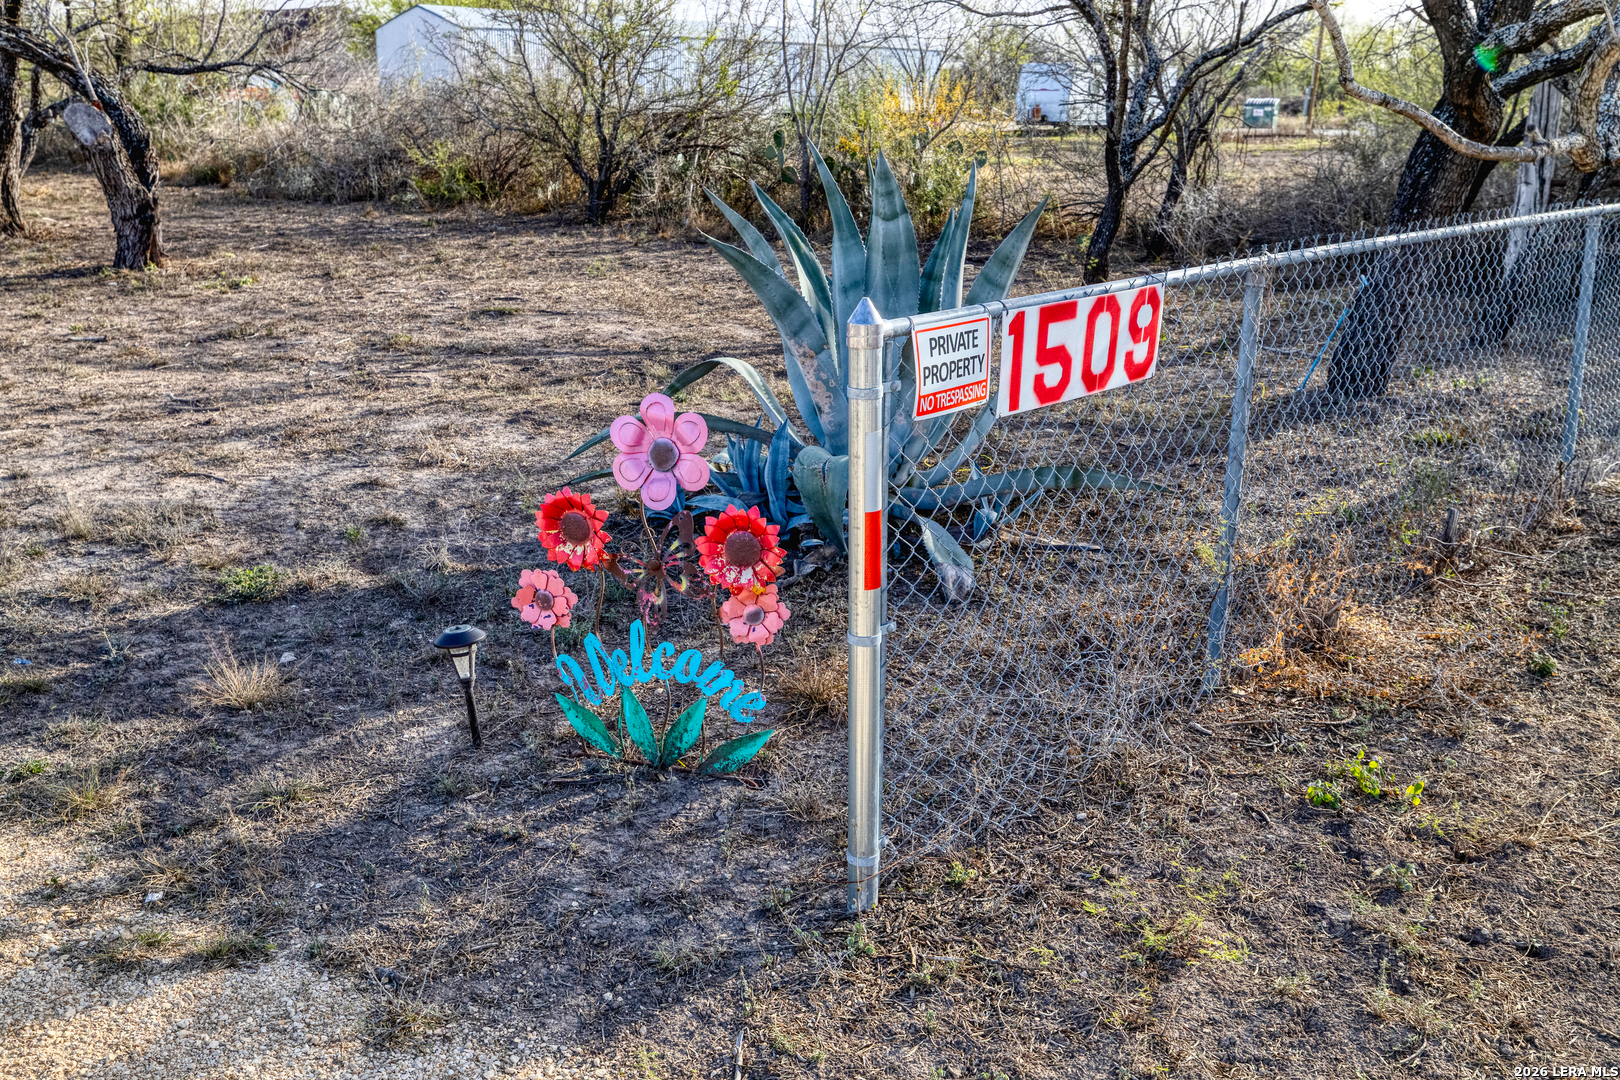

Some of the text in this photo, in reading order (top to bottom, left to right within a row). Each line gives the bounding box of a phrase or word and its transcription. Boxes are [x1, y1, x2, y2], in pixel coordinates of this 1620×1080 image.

[929, 329, 979, 357] PRIVATE
[1008, 285, 1161, 412] 1509
[923, 353, 985, 386] PROPERTY
[919, 382, 986, 412] NO TRESPASSING
[556, 618, 767, 723] Welcome
